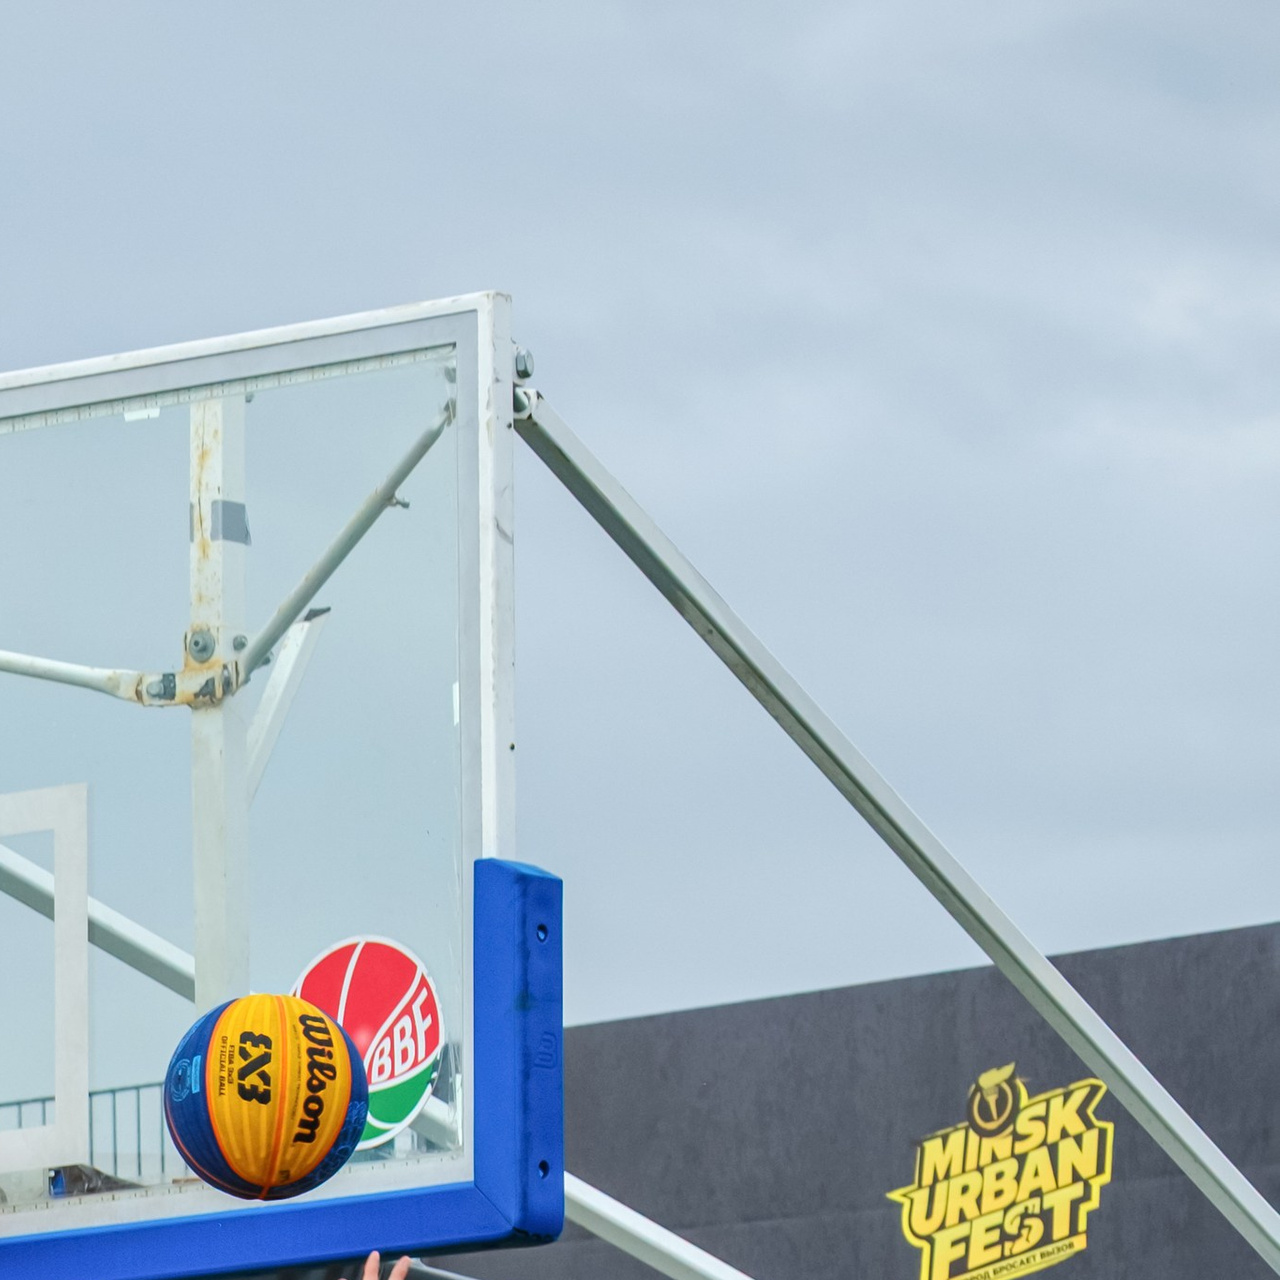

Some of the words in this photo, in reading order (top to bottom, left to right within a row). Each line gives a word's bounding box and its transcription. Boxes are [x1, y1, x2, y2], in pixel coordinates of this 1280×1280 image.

[293, 1014, 337, 1144] Wilson
[371, 986, 432, 1084] BBF
[905, 1128, 1099, 1236] URBAN
[922, 1086, 1091, 1187] MINSK
[993, 1254, 1037, 1276] БРОСАЕТ
[1040, 1241, 1075, 1260] ВЫЗОВ
